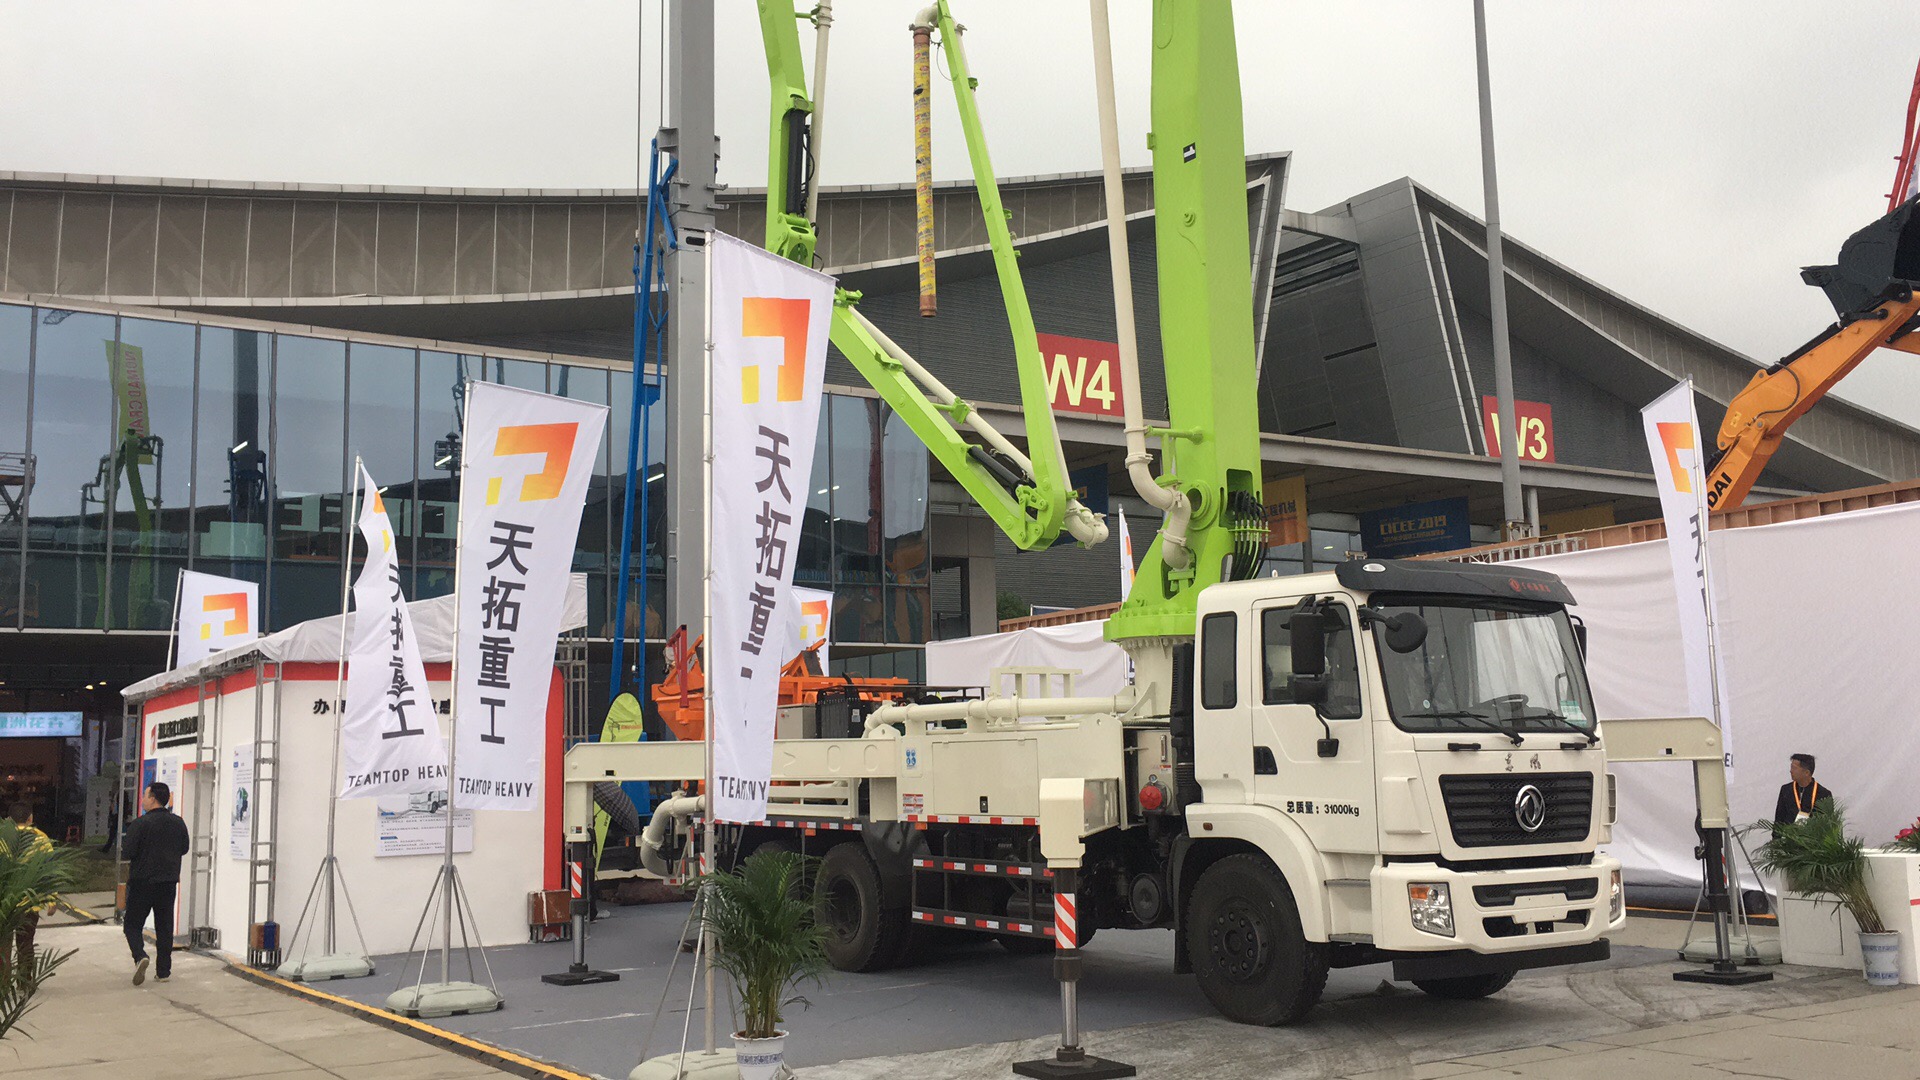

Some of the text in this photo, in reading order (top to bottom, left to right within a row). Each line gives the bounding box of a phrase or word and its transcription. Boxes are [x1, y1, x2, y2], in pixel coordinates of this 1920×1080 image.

[1039, 352, 1115, 411] W4
[1707, 472, 1733, 512] DAI
[740, 425, 792, 680] 天拓重
[477, 520, 535, 745] 天拓重工
[349, 765, 449, 787] TEAMTOP HEAV
[459, 777, 533, 797] TEAMTOP HEAVY
